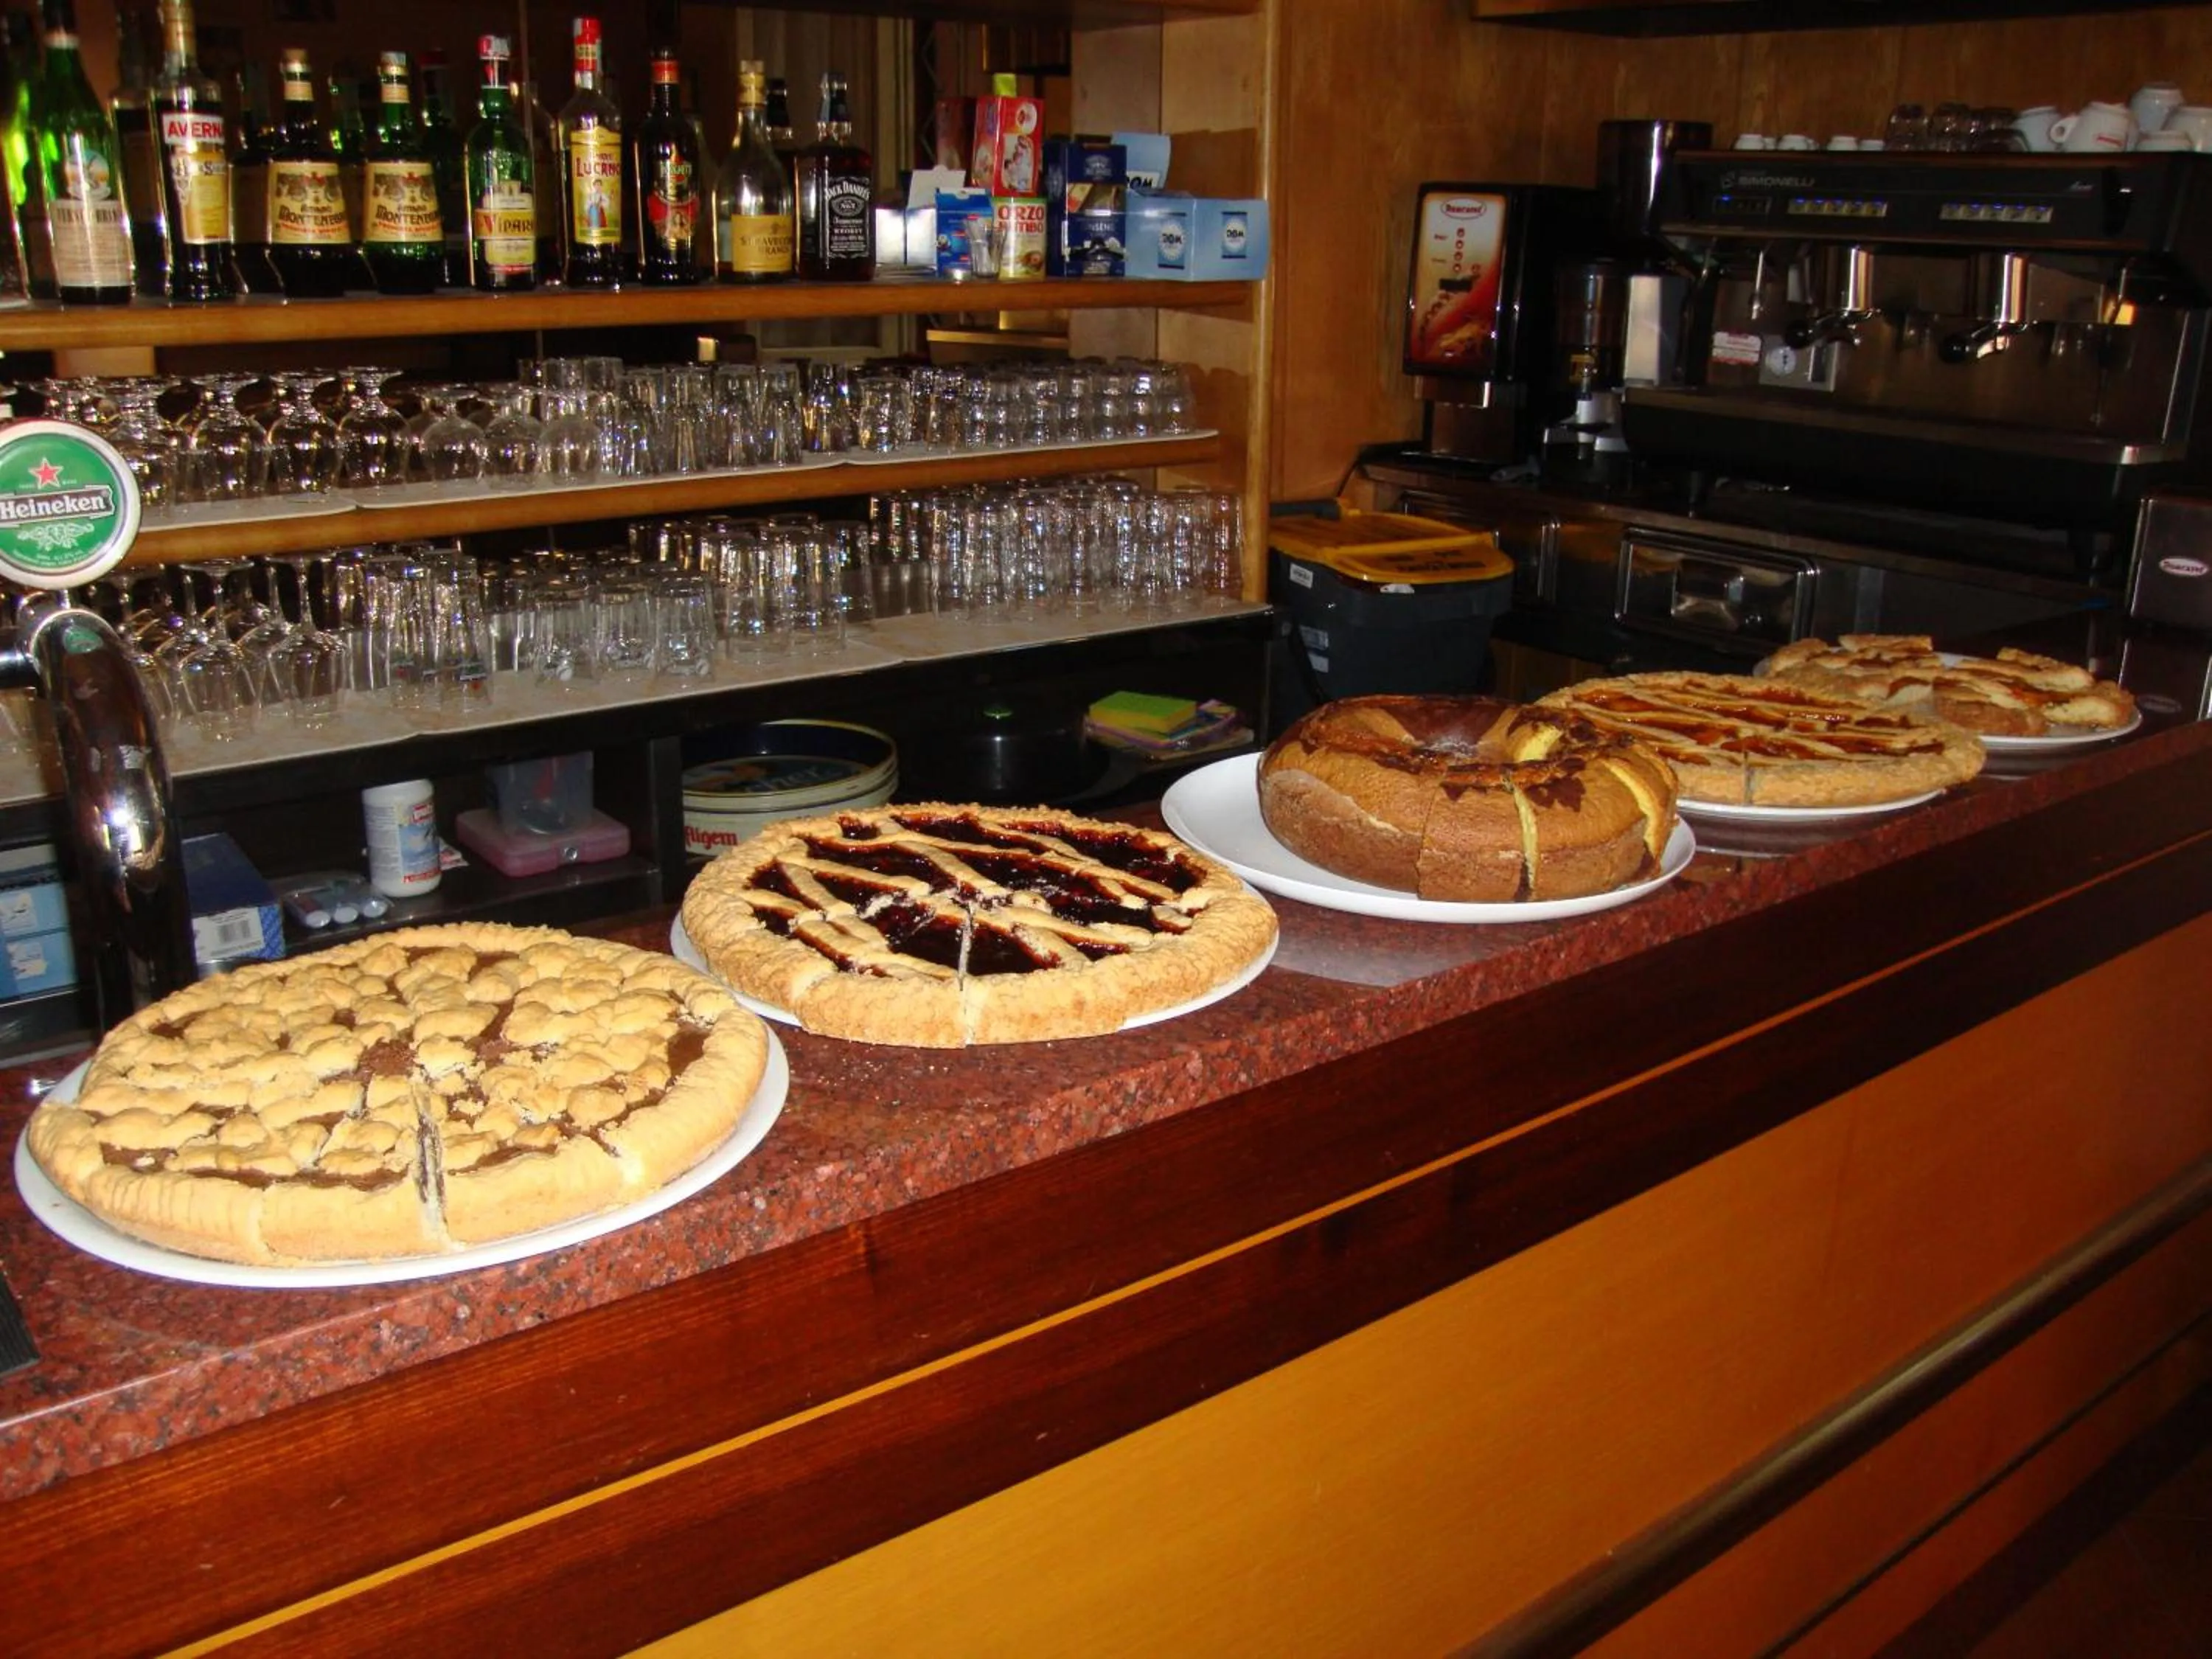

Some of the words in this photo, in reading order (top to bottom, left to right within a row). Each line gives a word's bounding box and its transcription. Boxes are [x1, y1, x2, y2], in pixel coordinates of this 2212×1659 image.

[167, 121, 223, 139] AVERN
[998, 205, 1046, 220] ORZO
[0, 495, 107, 519] Heineken
